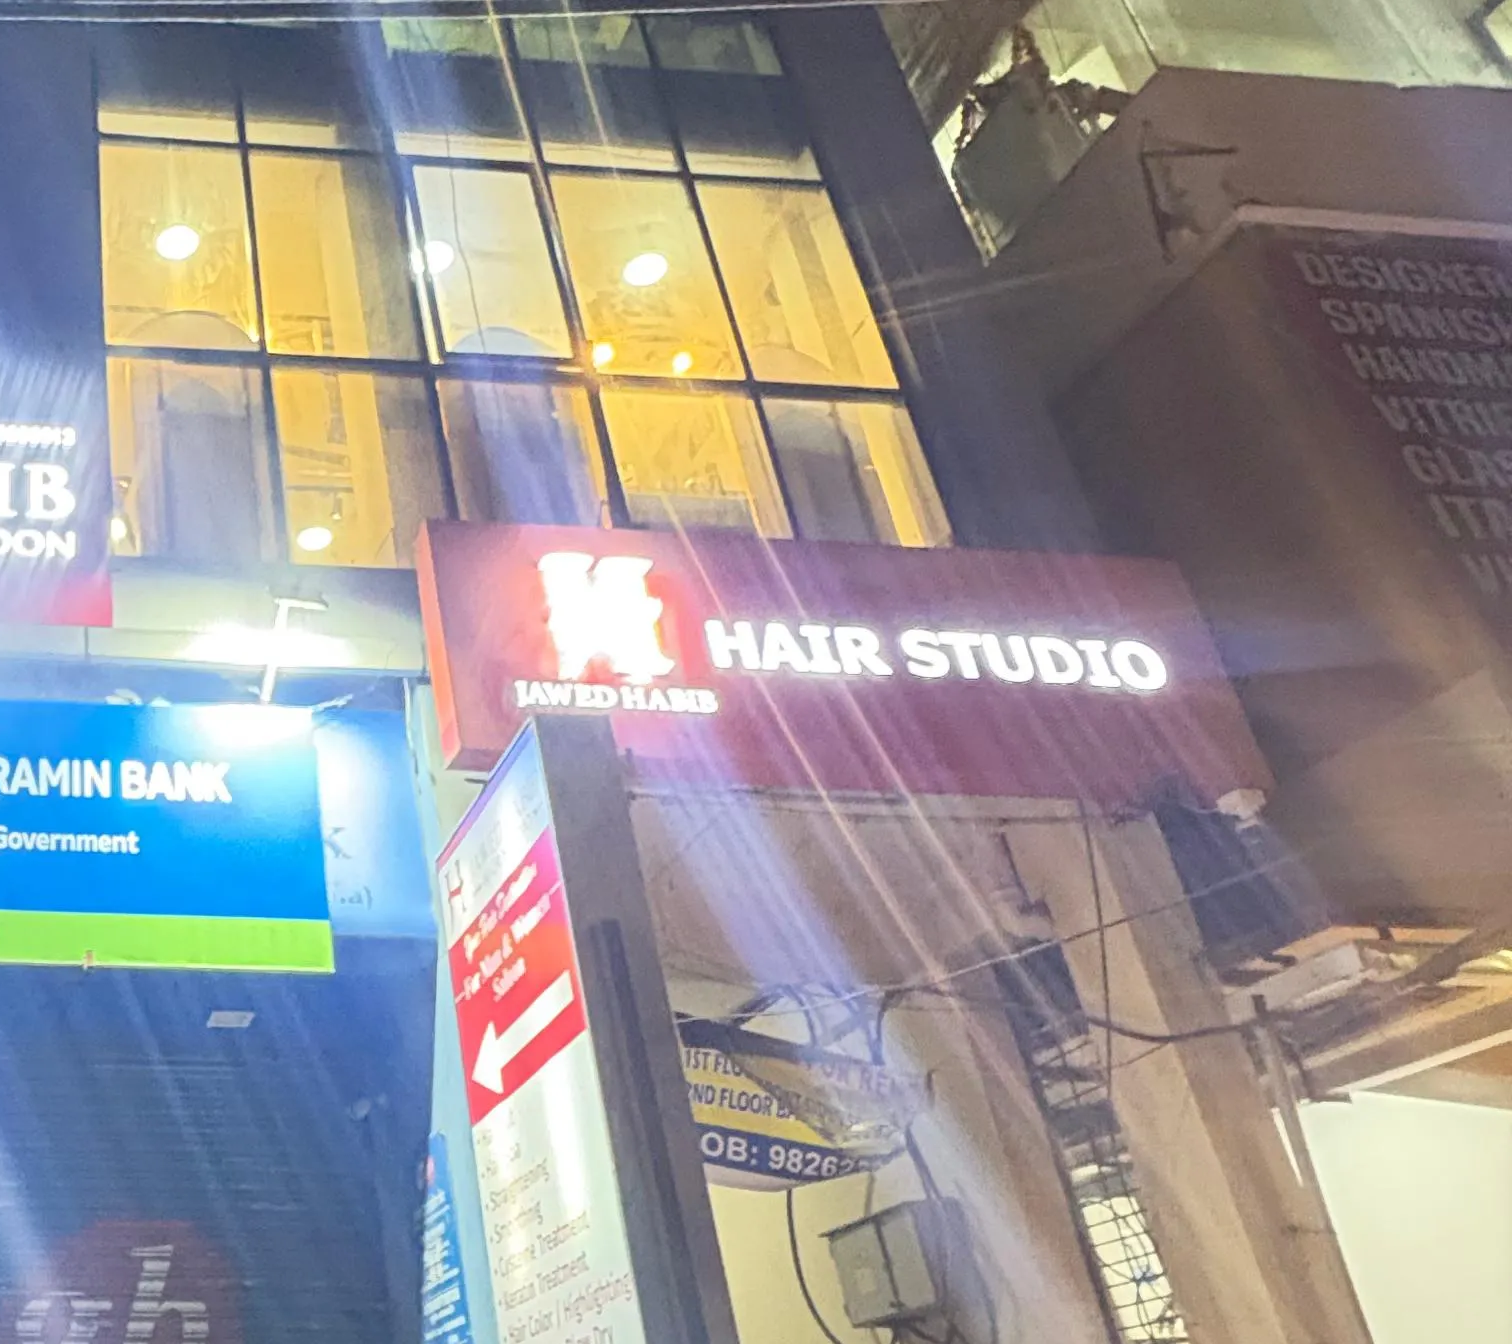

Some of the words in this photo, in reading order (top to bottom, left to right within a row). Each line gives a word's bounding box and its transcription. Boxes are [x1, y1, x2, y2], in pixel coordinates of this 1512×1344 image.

[704, 618, 893, 677] HAIR
[899, 626, 1169, 692] STUDIO
[514, 679, 619, 709] JAWED
[619, 685, 720, 715] HABIB
[120, 759, 233, 804] BANK
[719, 1087, 772, 1117] FLOOR
[699, 1130, 758, 1166] OB:
